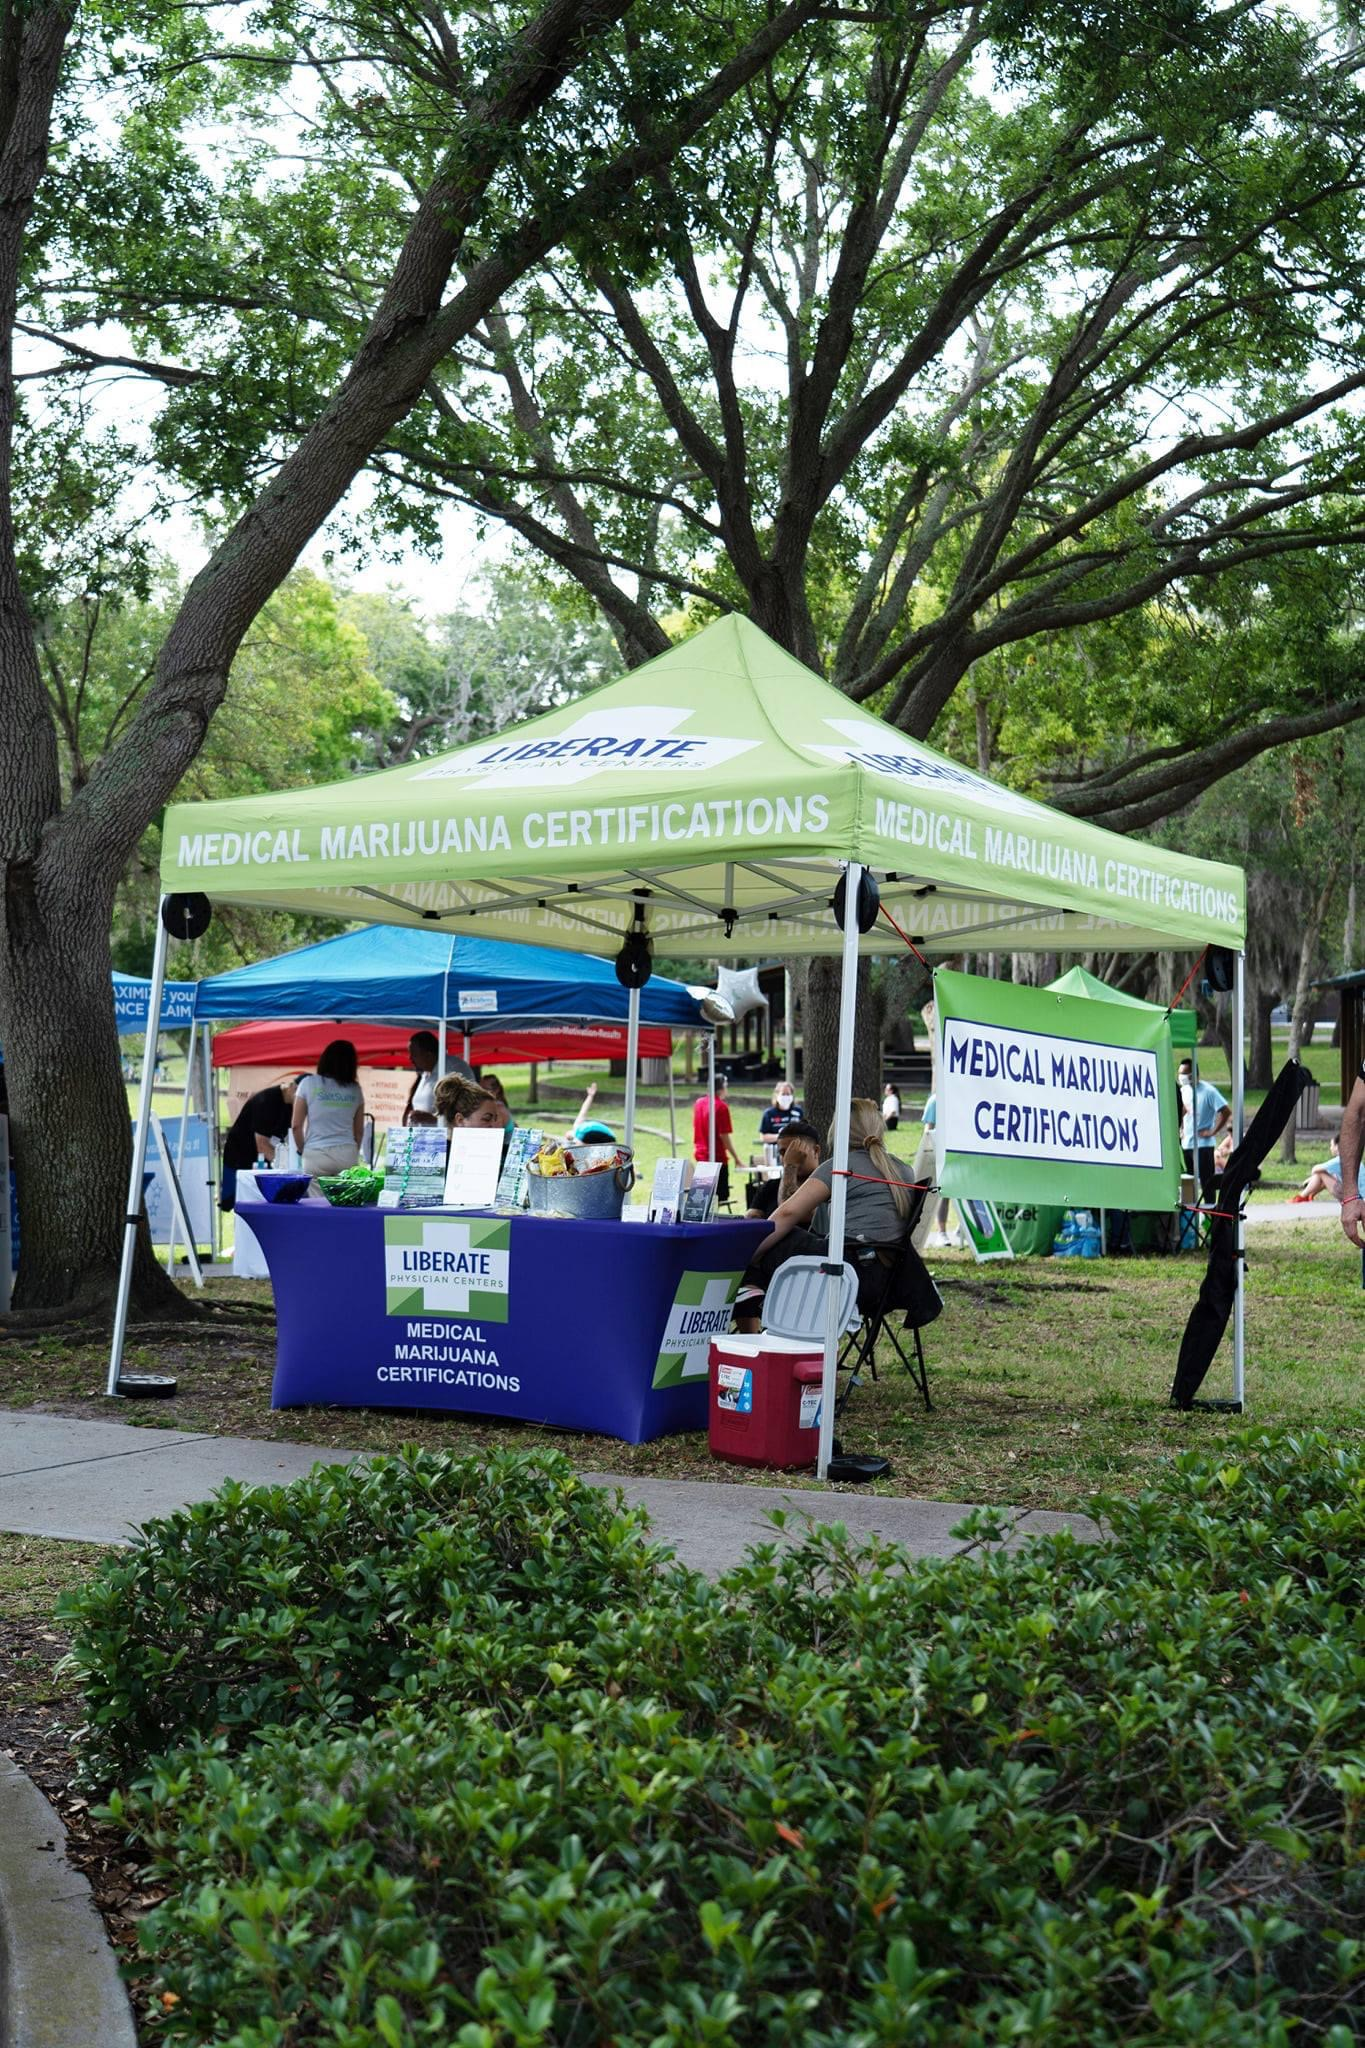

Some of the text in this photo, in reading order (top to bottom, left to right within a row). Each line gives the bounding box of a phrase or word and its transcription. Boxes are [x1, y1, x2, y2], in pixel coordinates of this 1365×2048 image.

[477, 737, 707, 765] LIBERATE
[425, 759, 708, 778] PHYSICIAN CENTERS
[176, 794, 830, 868] MEDICAL MARIJUANA CERTIFICATIONS
[874, 797, 1238, 925] MEDICAL MARIJUANA CERTIFICATIONS
[949, 1035, 1156, 1100] MEDICAL MARIJUANA
[974, 1100, 1139, 1153] CERTIFICATIONS
[402, 1250, 491, 1275] LIBERATE
[390, 1274, 505, 1289] PHYSICIAN CENTERS
[406, 1322, 487, 1343] MEDICAL
[679, 1309, 731, 1335] LIBERATE
[394, 1344, 500, 1367] MARIJUANA
[664, 1338, 705, 1348] PHYSICIAN
[376, 1366, 521, 1393] CERTIFICATIONS
